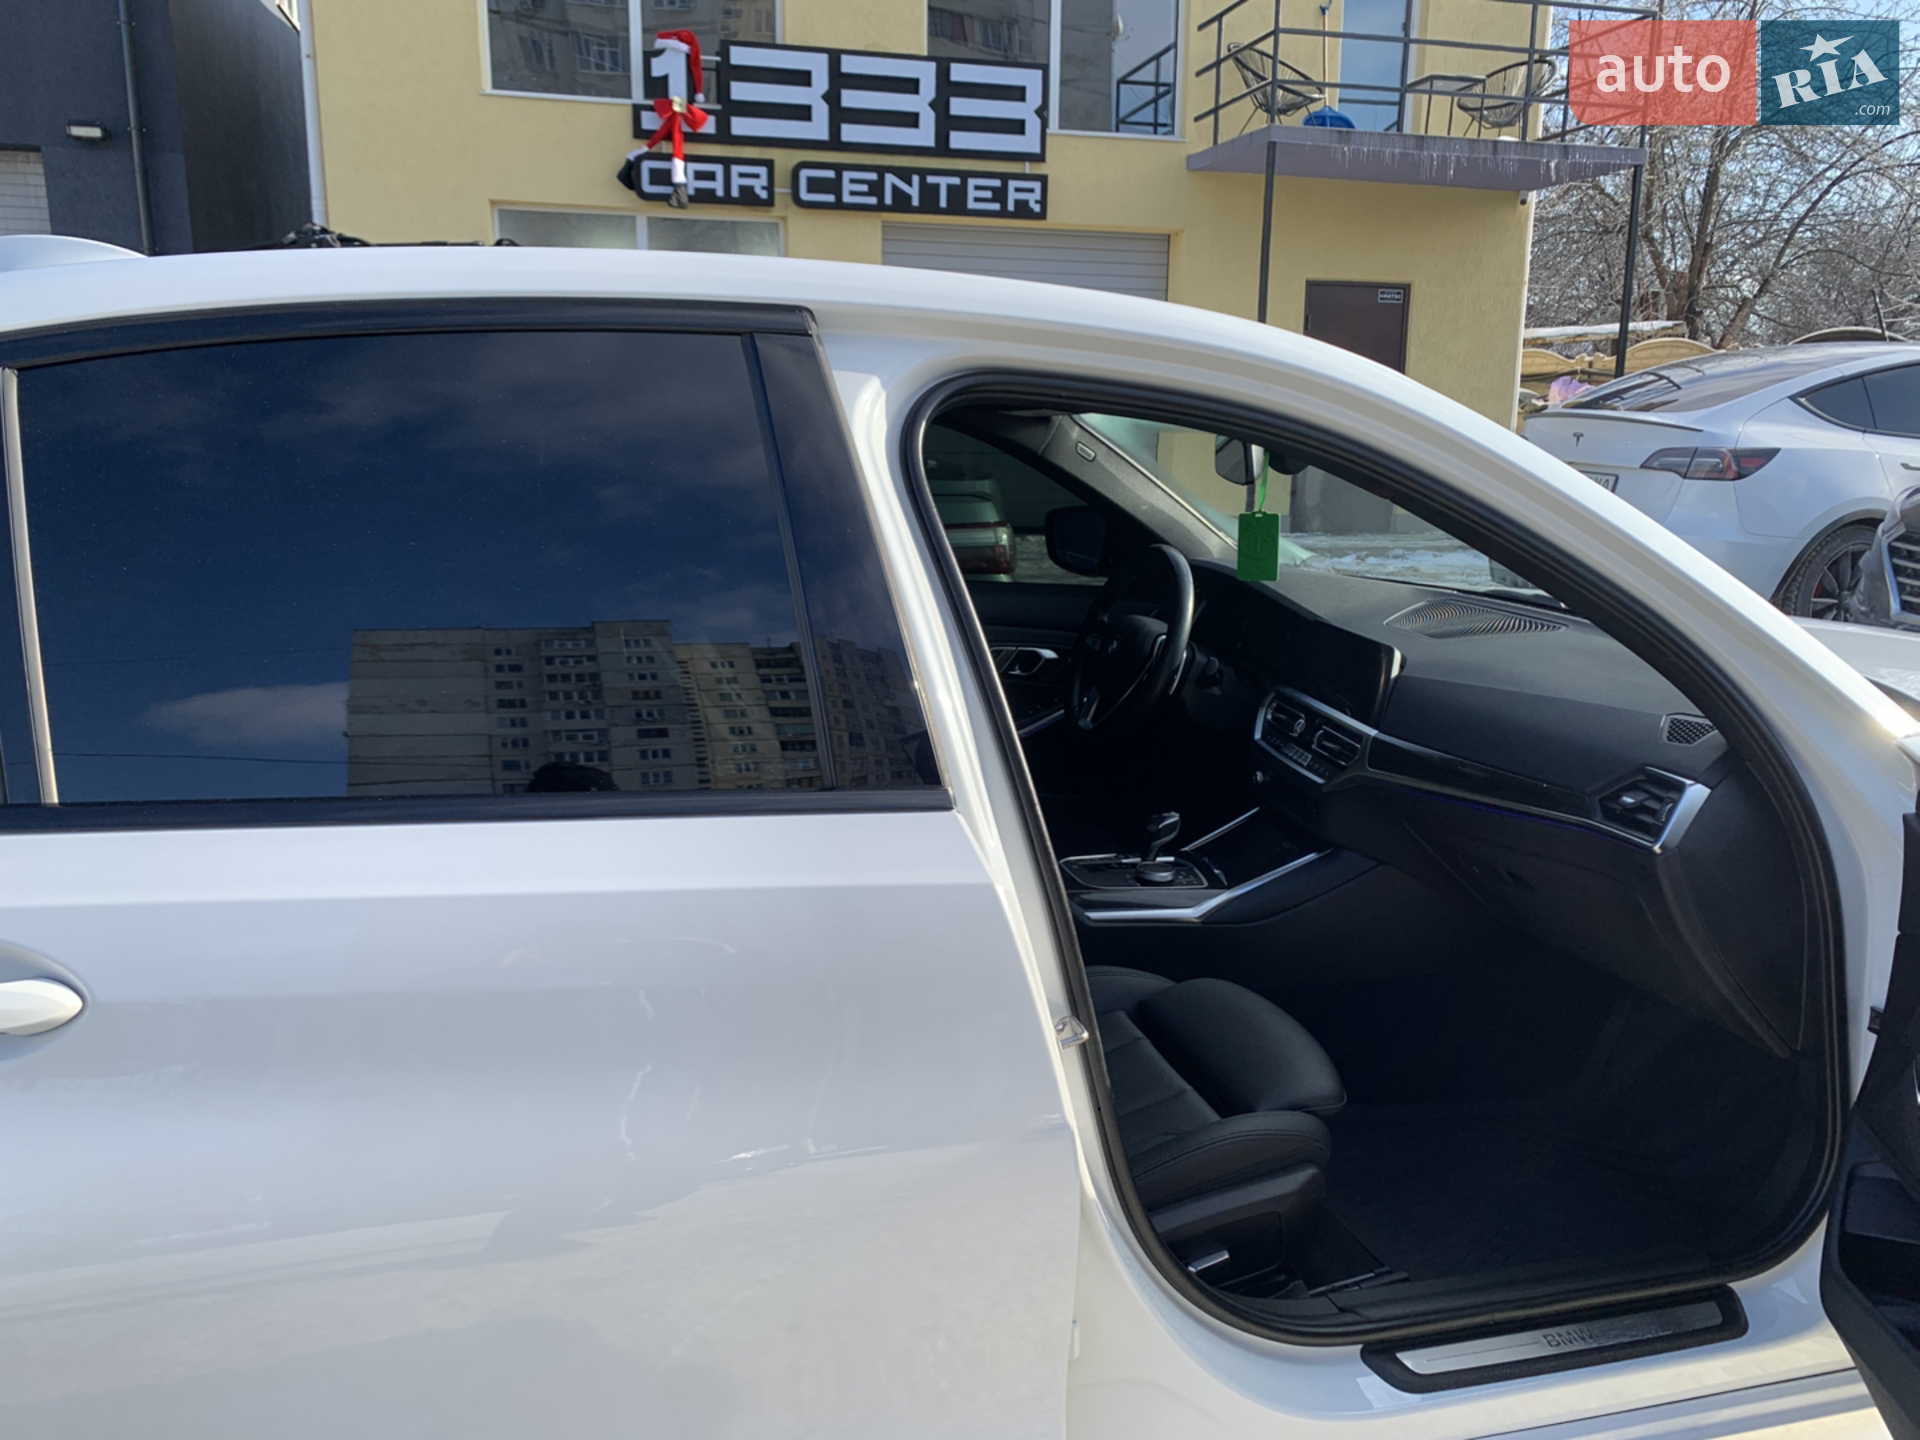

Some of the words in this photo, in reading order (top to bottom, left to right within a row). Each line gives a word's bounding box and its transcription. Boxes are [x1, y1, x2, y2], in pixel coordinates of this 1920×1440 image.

[641, 45, 1043, 155] 1333
[640, 160, 769, 200] CAR
[798, 168, 1042, 214] CENTER
[1542, 1327, 1595, 1348] BMW
